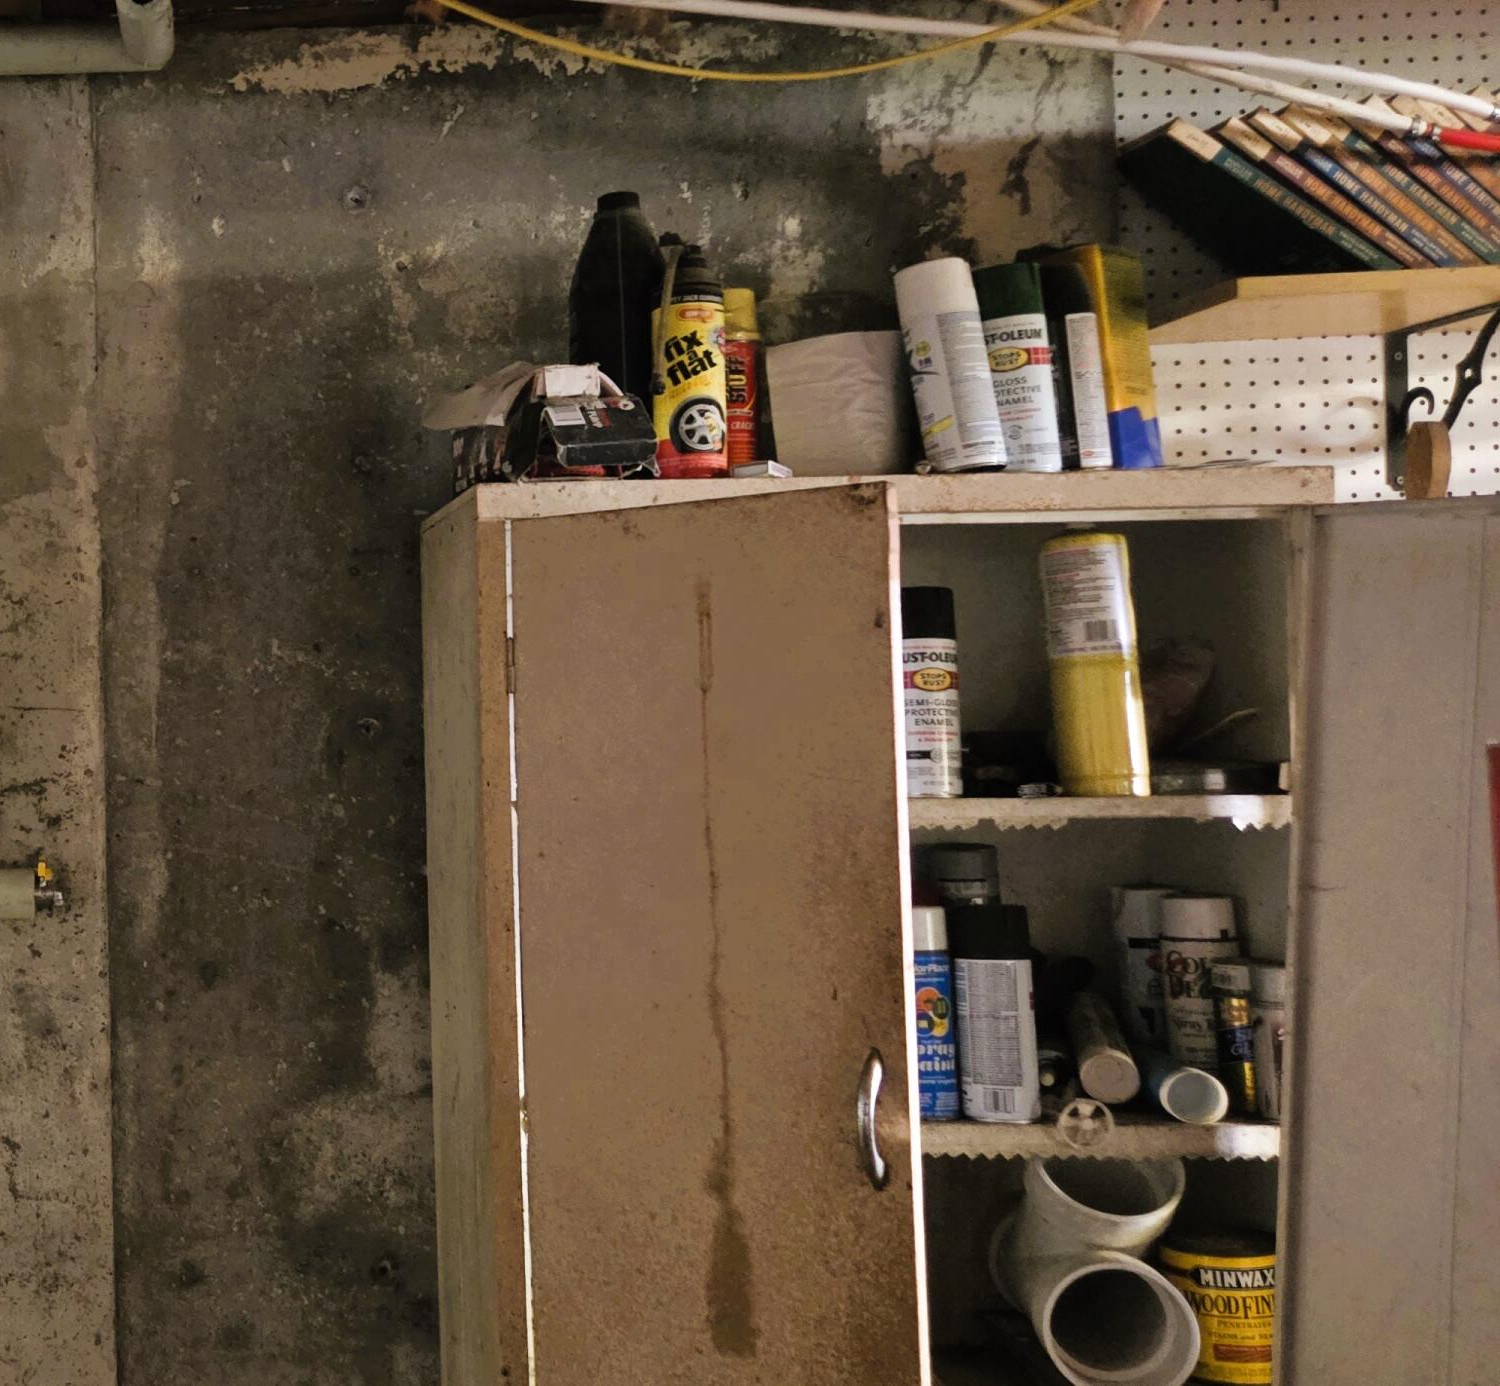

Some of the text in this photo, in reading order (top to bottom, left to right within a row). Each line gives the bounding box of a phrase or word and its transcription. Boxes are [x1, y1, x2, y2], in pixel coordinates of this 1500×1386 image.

[1331, 169, 1410, 233] HOME HANDYMAN
[1381, 161, 1458, 226] HOME HANDYMAN
[1465, 182, 1500, 217] HANDY
[1281, 196, 1336, 236] HANDYMAN
[665, 331, 703, 362] fix
[984, 328, 1042, 346] ST-OLEUM
[667, 350, 717, 387] flat
[997, 396, 1034, 407] NAMEL
[903, 651, 957, 663] UST-OLEU
[904, 699, 958, 707] SEMI-GLOS
[905, 708, 959, 717] PROTECTI
[915, 718, 953, 726] ENAMEL
[918, 1056, 955, 1071] aint
[1200, 1268, 1275, 1288] MINWAX
[1240, 1294, 1275, 1319] FIN
